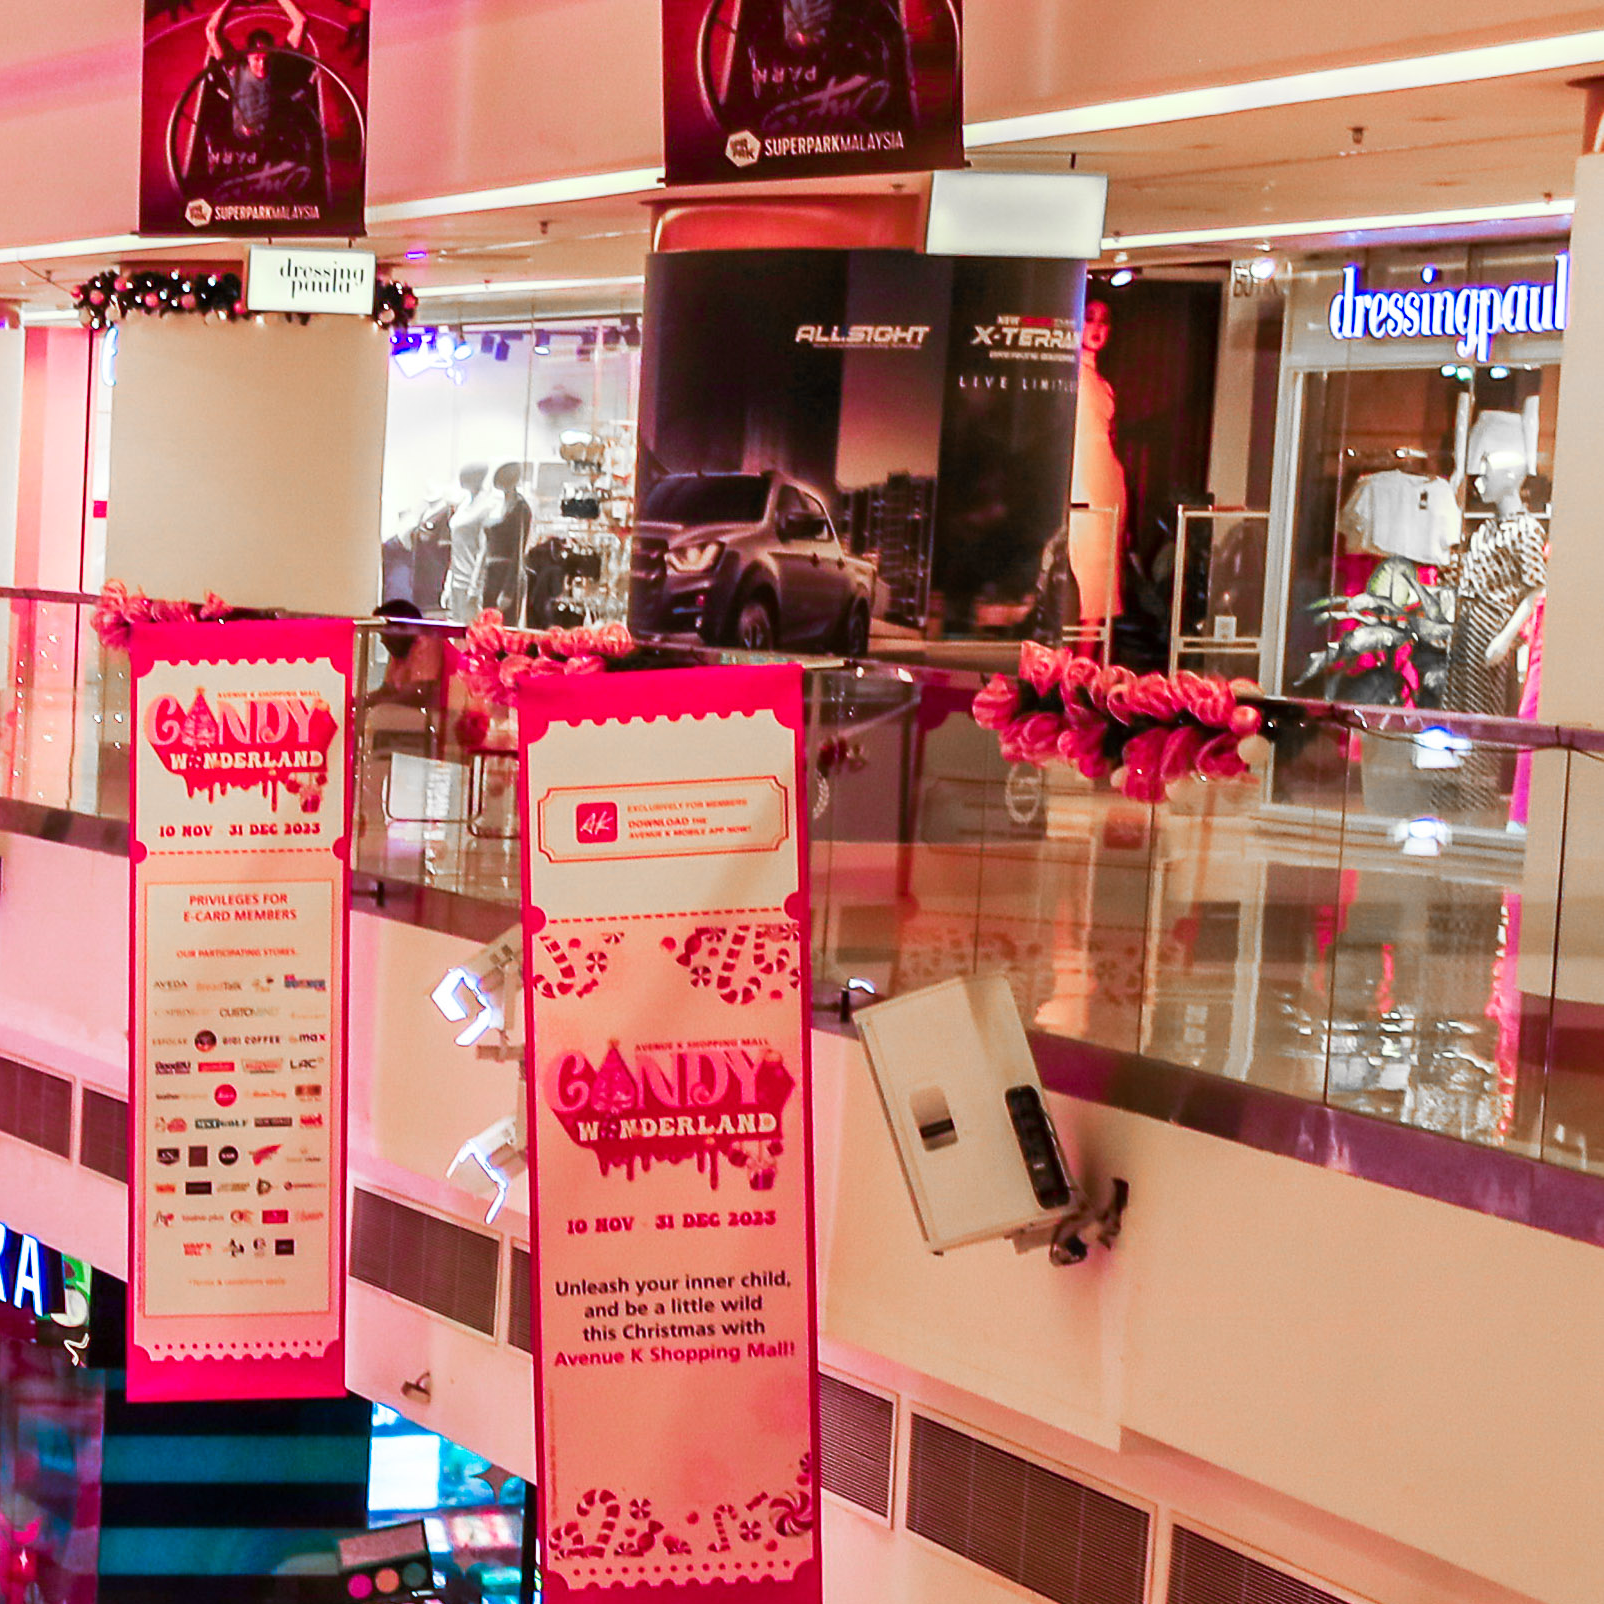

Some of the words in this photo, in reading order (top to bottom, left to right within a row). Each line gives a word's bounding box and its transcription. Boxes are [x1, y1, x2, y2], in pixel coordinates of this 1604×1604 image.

[764, 130, 905, 158] SUPERPARKMALAYSIA
[279, 258, 365, 285] dressing
[958, 376, 1008, 390] LIVE
[190, 894, 260, 907] PRIVILEGES
[263, 893, 289, 906] FOR
[183, 911, 230, 924] E-CARD
[233, 909, 297, 922] MEMBERS
[567, 1219, 588, 1235] 10
[595, 1217, 634, 1233] NOV
[656, 1214, 675, 1230] 31
[682, 1212, 721, 1228] DEC
[728, 1210, 777, 1227] 2023
[555, 1278, 630, 1297] Unleash
[635, 1276, 678, 1295] your
[685, 1274, 735, 1291] inner
[741, 1270, 792, 1289] child,
[584, 1303, 620, 1319] and
[625, 1300, 648, 1317] be
[654, 1304, 666, 1316] a
[671, 1298, 716, 1315] little
[721, 1295, 764, 1313] wild
[583, 1325, 617, 1342] this
[622, 1322, 715, 1340] Christmas
[722, 1320, 766, 1337] with
[554, 1350, 625, 1367] Avenue
[630, 1348, 644, 1363] K
[651, 1345, 741, 1366] Shopping
[747, 1341, 795, 1359] Mall!
